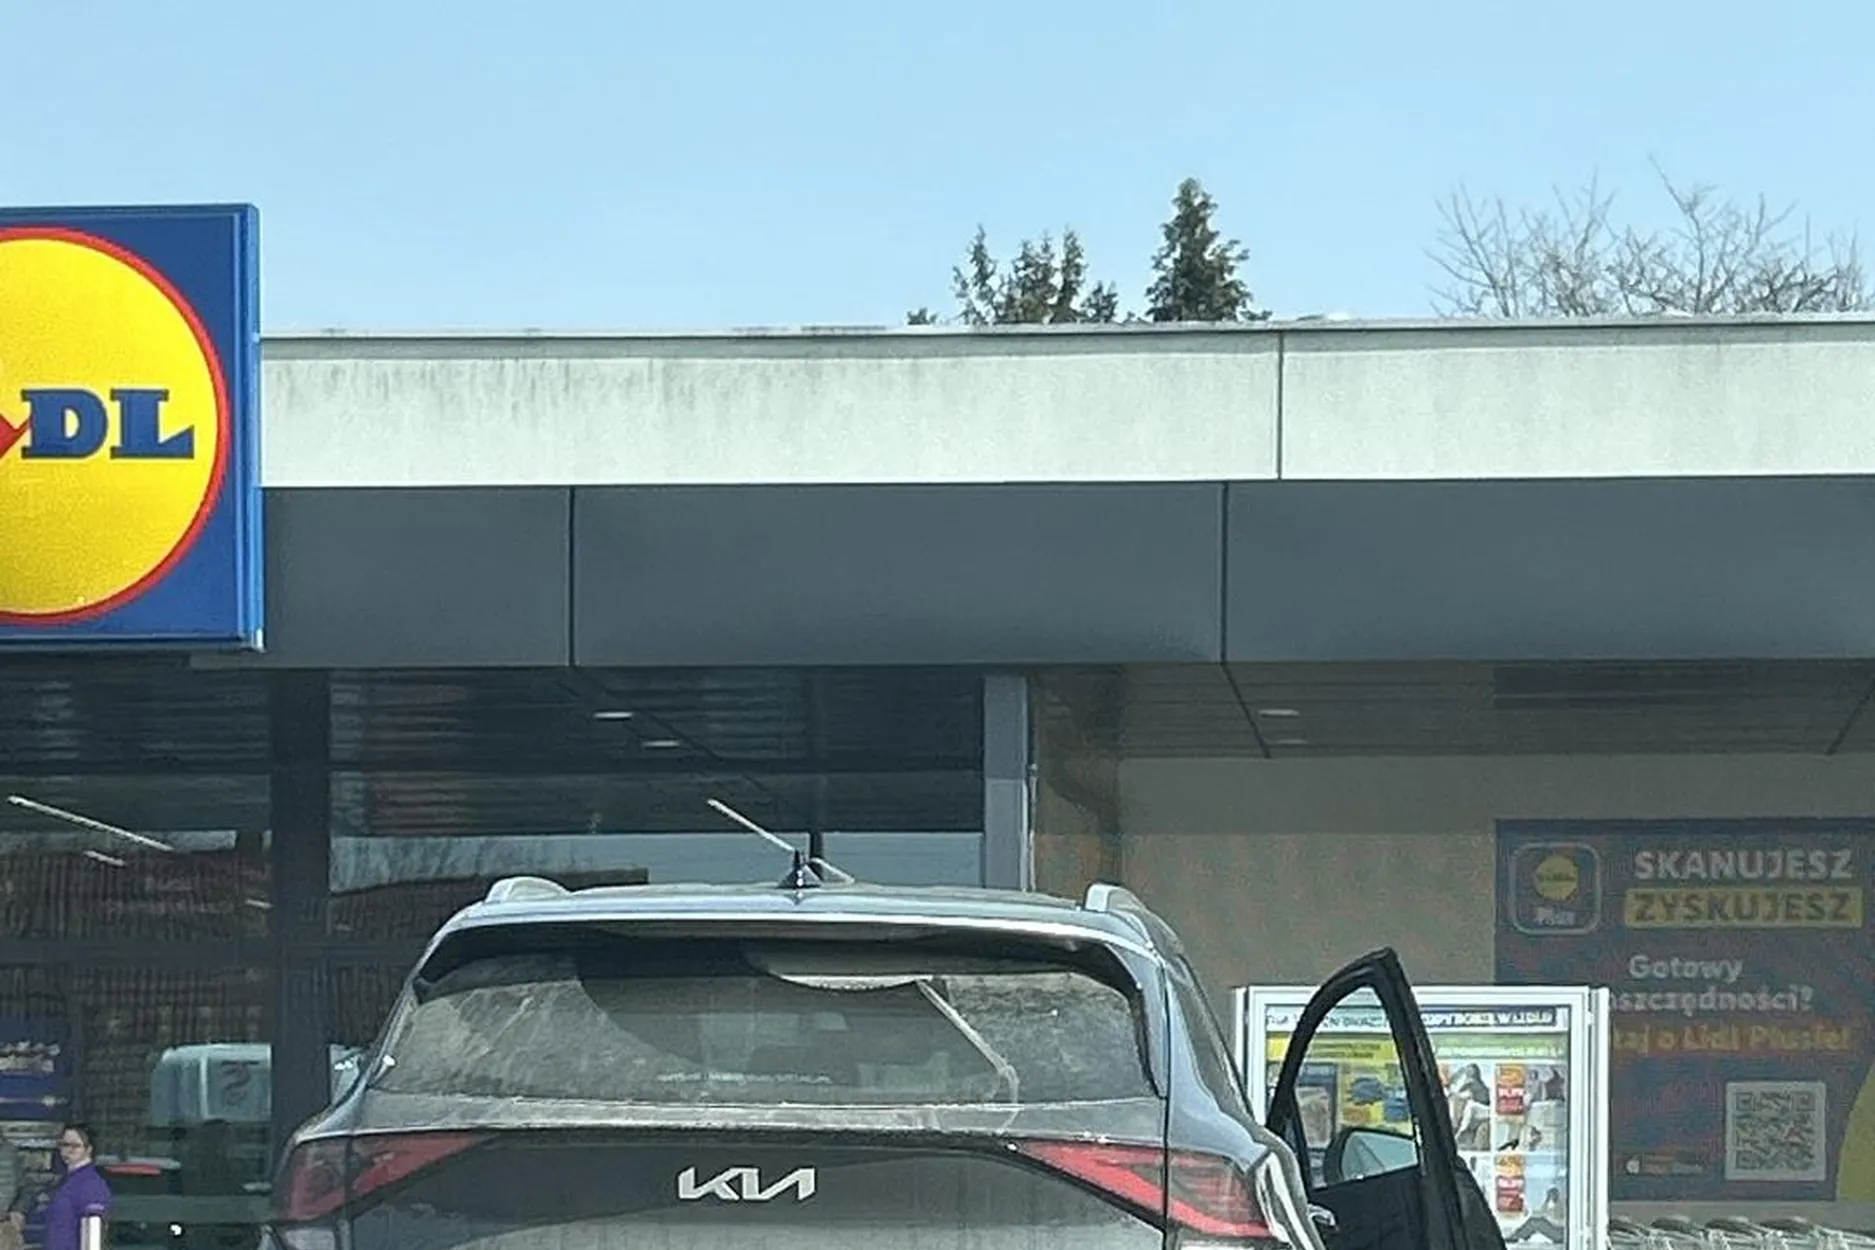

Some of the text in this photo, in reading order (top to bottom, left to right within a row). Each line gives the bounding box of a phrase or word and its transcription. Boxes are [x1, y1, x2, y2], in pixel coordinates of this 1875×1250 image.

[0, 388, 195, 459] DL
[1633, 850, 1853, 880] SKANUJESZ
[1633, 892, 1852, 922] ZYSKUJESZ
[1628, 953, 1744, 983] Gotowy
[677, 1166, 816, 1201] KIA
